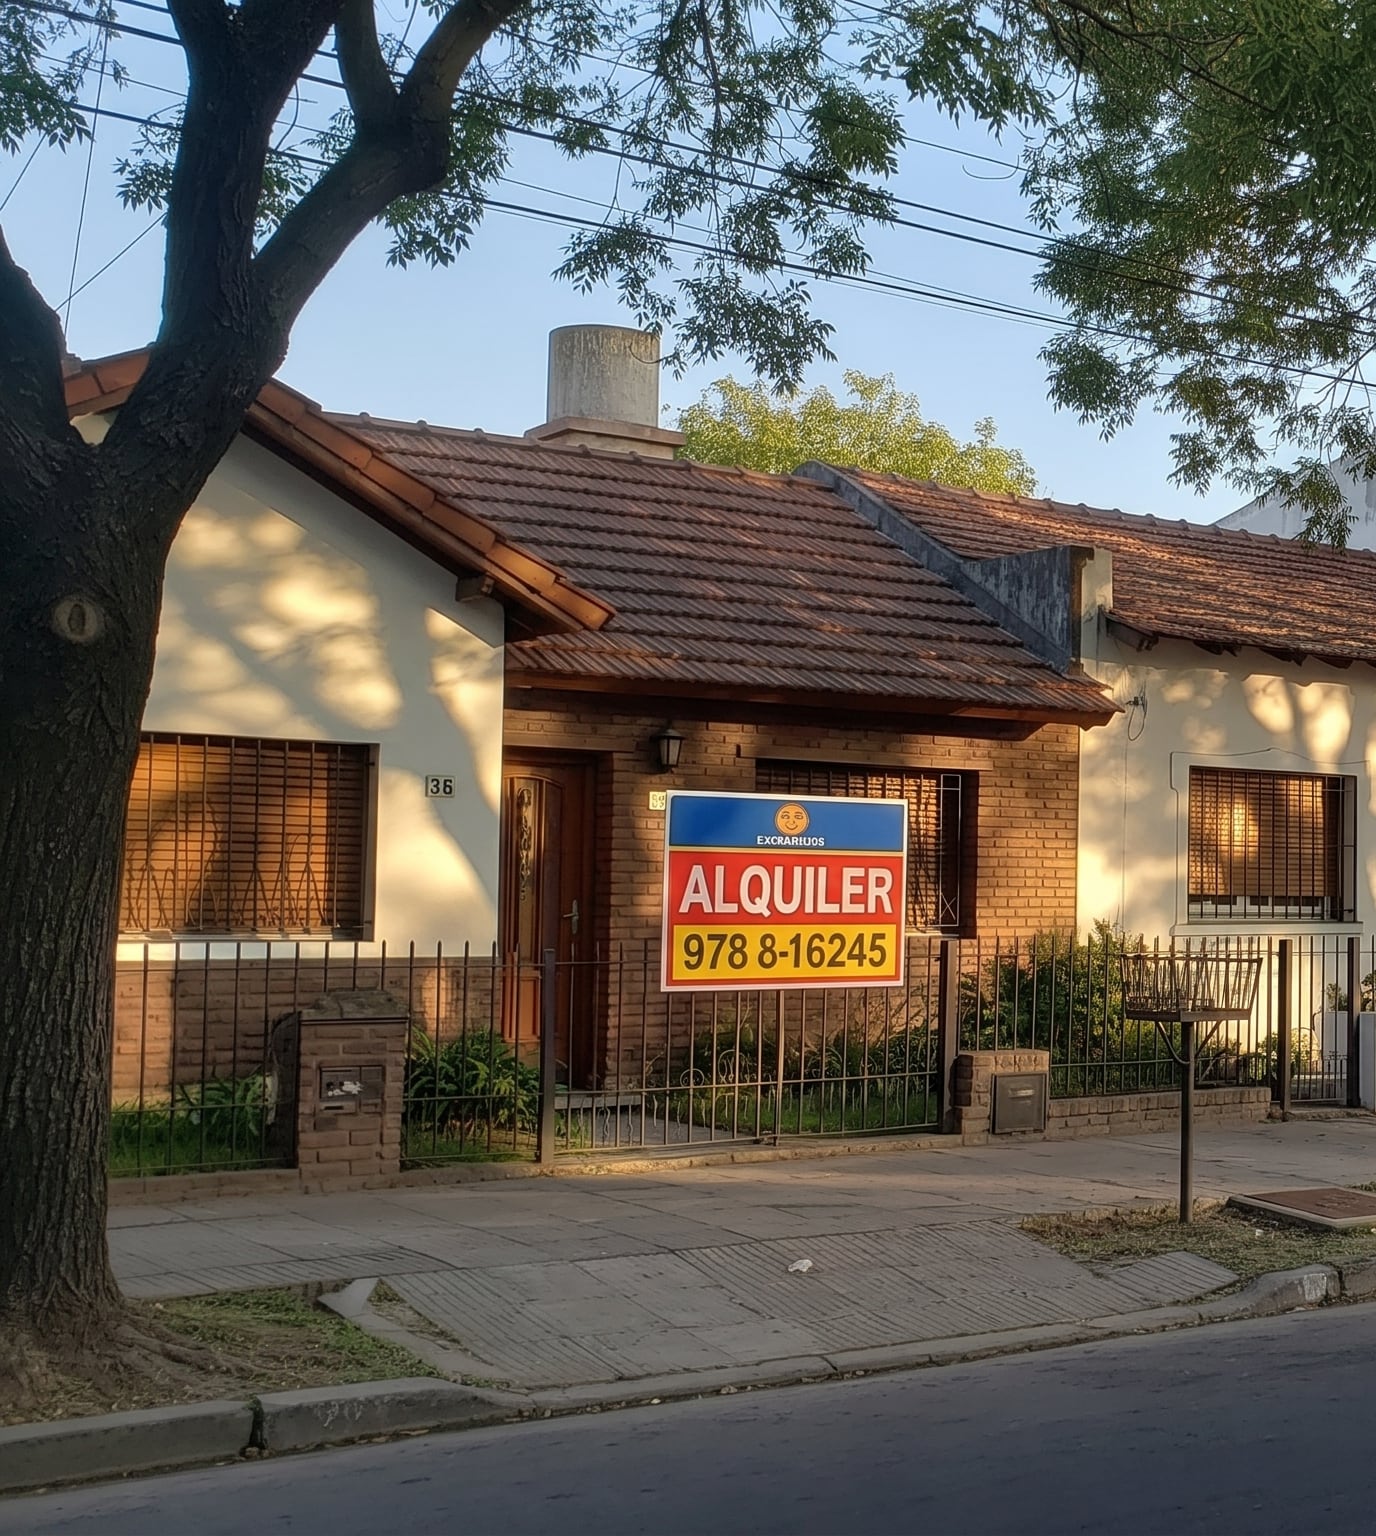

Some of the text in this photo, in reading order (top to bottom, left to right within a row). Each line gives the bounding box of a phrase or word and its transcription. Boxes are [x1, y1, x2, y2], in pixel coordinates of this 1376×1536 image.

[430, 778, 453, 795] 36
[678, 864, 894, 918] ALQUILER
[683, 932, 887, 971] 978 8-16245
